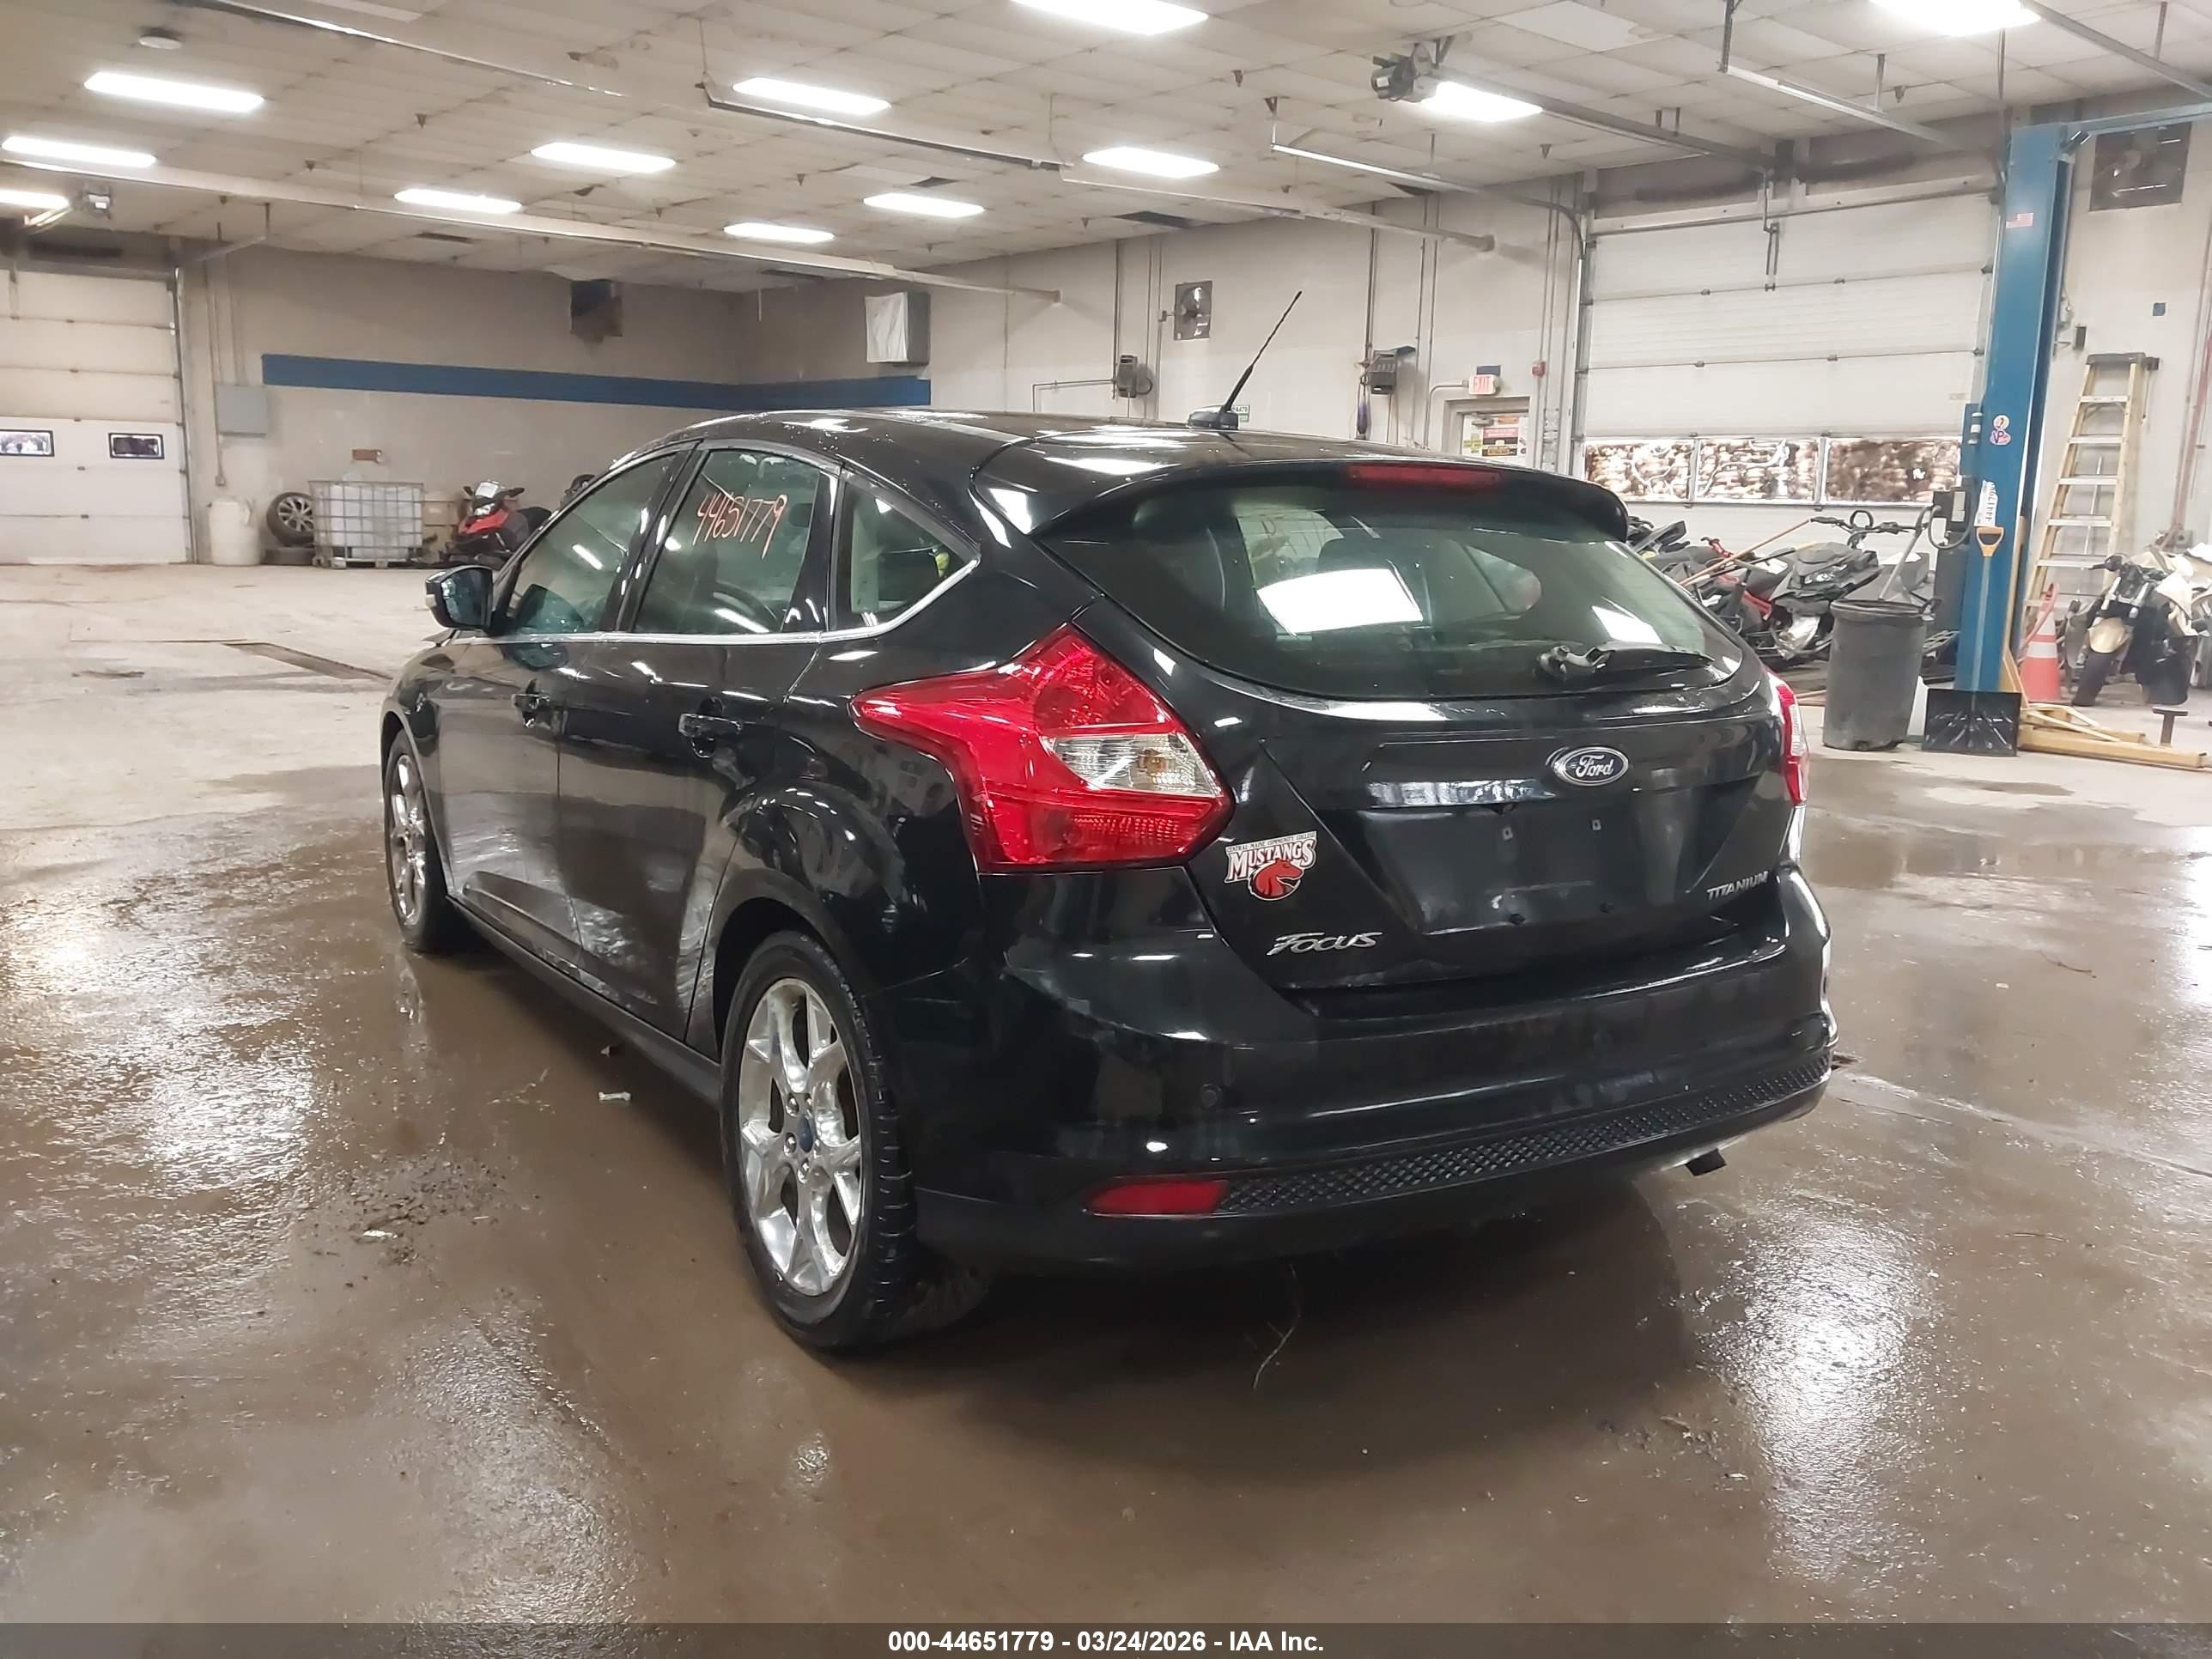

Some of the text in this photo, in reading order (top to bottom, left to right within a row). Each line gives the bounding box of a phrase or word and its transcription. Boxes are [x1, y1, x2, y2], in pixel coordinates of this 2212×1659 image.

[1474, 375, 1491, 392] EXIT
[692, 492, 787, 559] 44651779
[1576, 755, 1614, 777] Ford
[1228, 838, 1315, 880] MUSTANGS
[1706, 871, 1769, 900] TITANIUM
